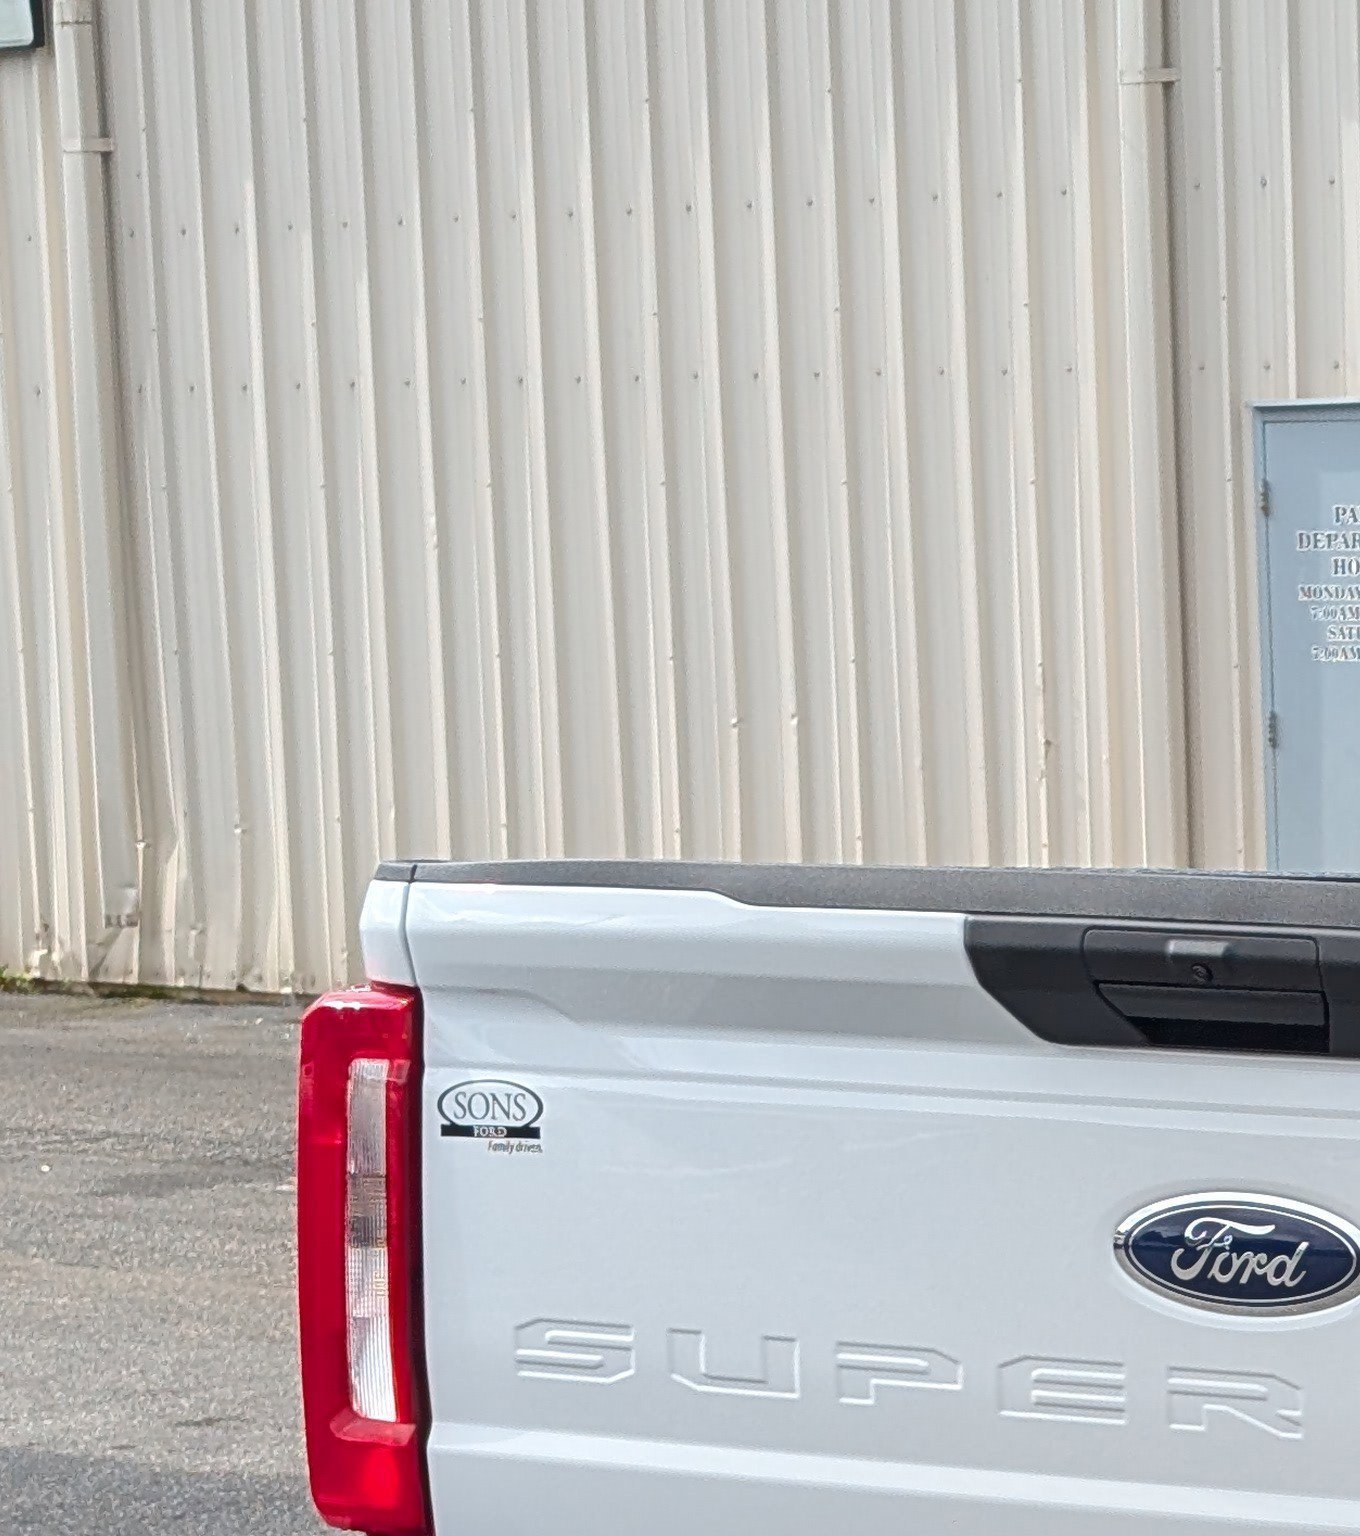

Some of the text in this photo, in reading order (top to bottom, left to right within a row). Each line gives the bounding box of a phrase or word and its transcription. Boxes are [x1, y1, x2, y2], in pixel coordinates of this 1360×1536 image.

[453, 1091, 527, 1122] SONS
[473, 1126, 508, 1138] FORD
[1170, 1216, 1309, 1288] Ford
[514, 1317, 1305, 1437] SUPER
